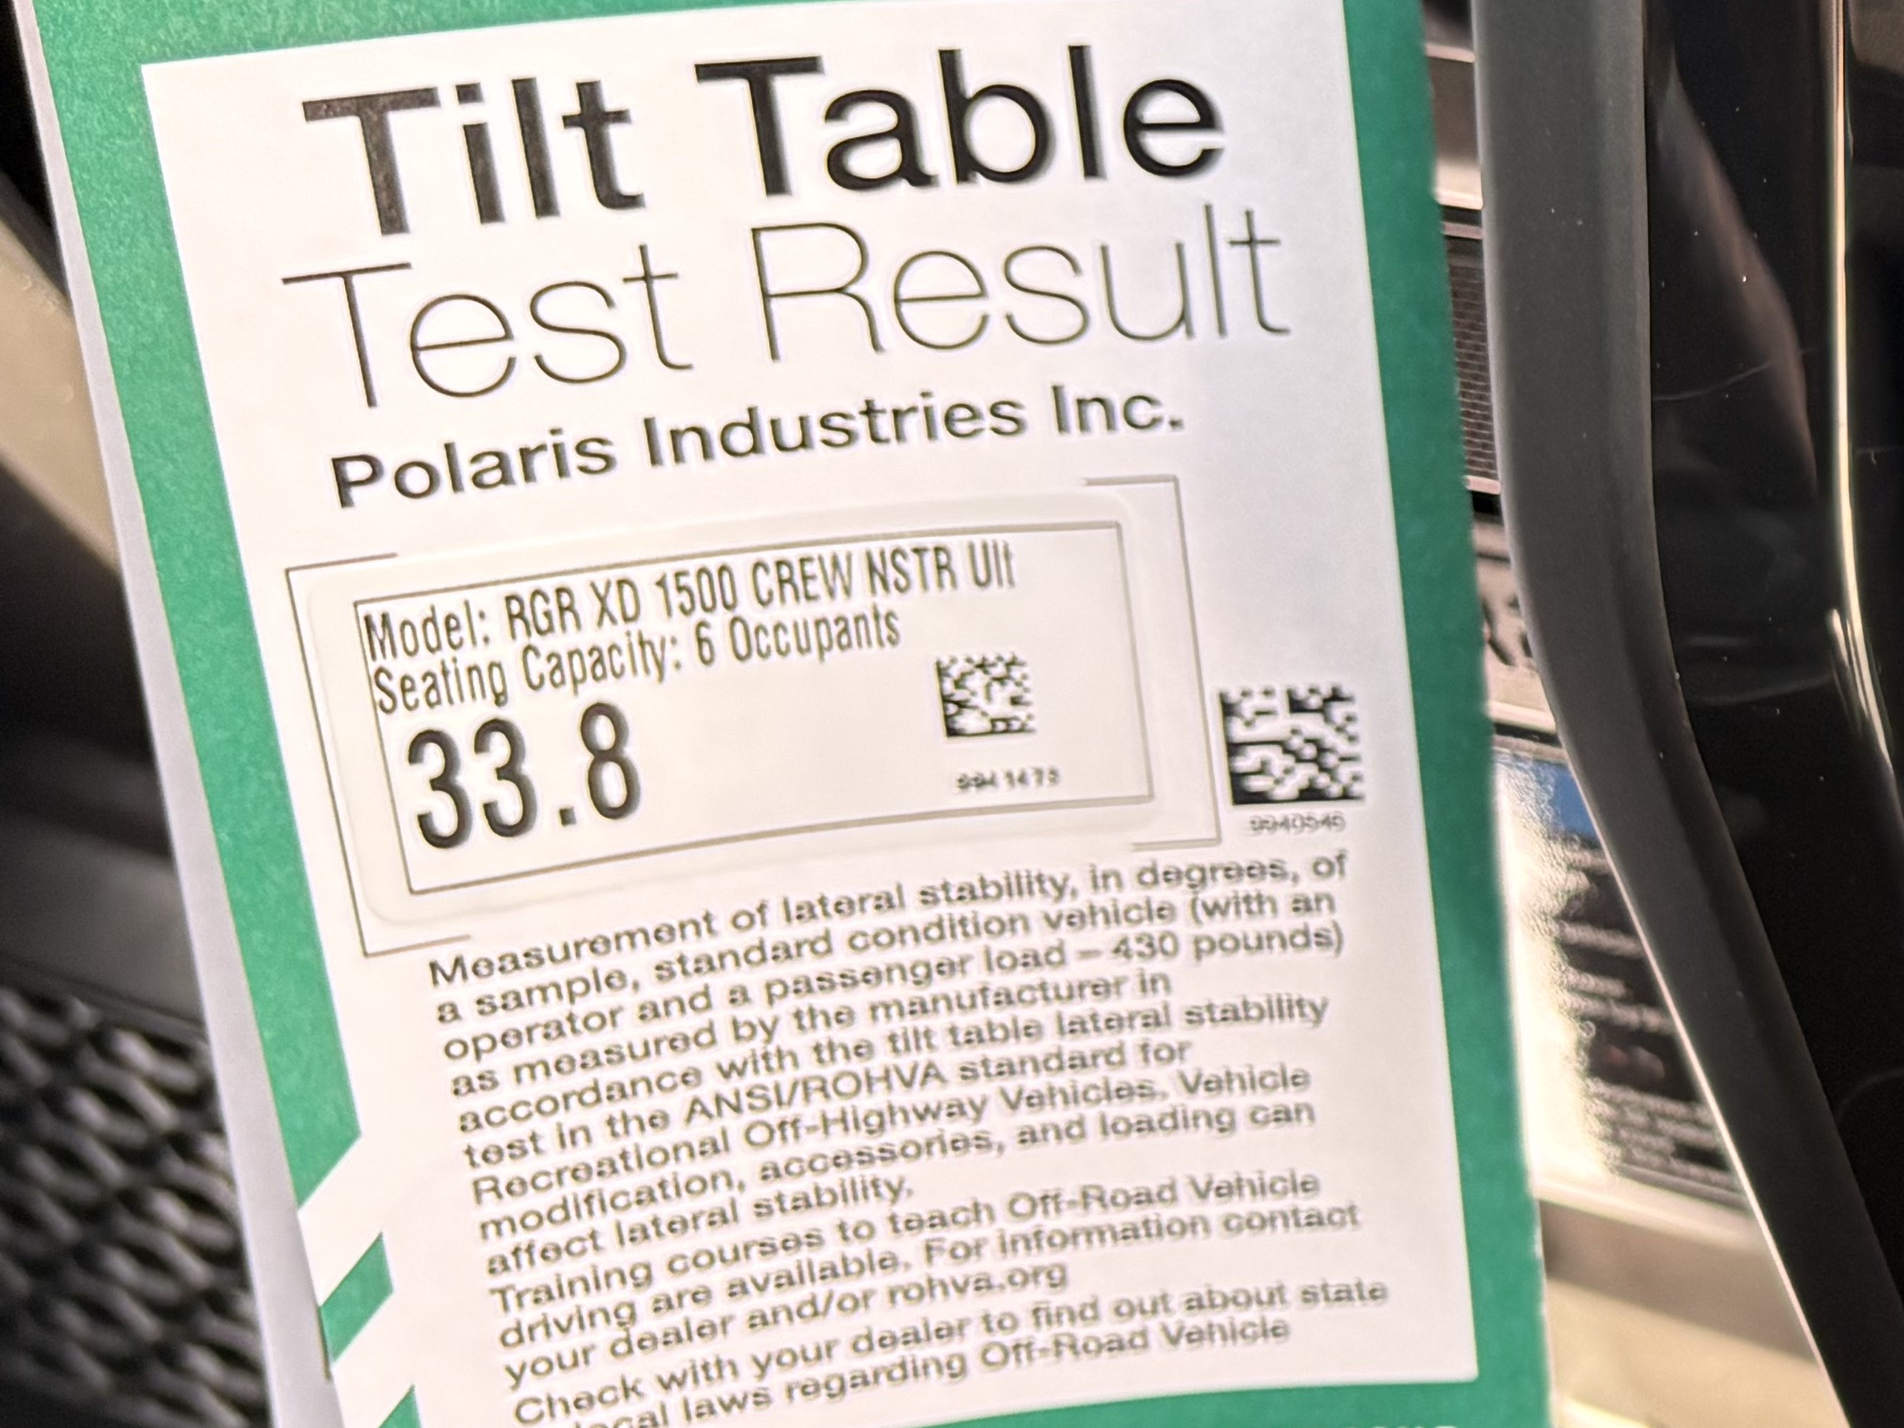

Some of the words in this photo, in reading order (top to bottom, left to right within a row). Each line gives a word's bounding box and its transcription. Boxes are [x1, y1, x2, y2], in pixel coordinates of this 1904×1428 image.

[302, 75, 645, 237] Tilt
[694, 44, 1226, 197] Table
[281, 242, 694, 408] Test
[750, 203, 1290, 360] Result
[329, 418, 617, 508] Polaris
[644, 388, 1028, 469] Industries
[1052, 384, 1185, 435] Inc.
[363, 599, 491, 662] Model:
[504, 586, 581, 643] RGR
[593, 575, 641, 627] XD
[656, 565, 739, 618] 1500
[753, 552, 853, 607] CREW
[867, 543, 956, 597] NSTR
[374, 658, 509, 715] Seating
[522, 629, 682, 694] Capacity:
[697, 622, 715, 667] 6
[729, 606, 901, 663] Occupants
[407, 702, 641, 850] 33.8
[429, 909, 718, 987] Measurement
[730, 900, 769, 933] of
[782, 882, 906, 924] lateral
[1089, 863, 1123, 892] in
[1137, 857, 1299, 889] degrees,
[1312, 850, 1348, 879] of
[436, 998, 460, 1024] a
[475, 969, 641, 1017] sample,
[655, 929, 832, 983] standard
[848, 909, 1029, 953] condition
[1043, 896, 1175, 931] vehicle
[1191, 889, 1276, 924] (with
[1291, 891, 1335, 915] an
[444, 1005, 624, 1062] operator
[638, 984, 712, 1023] and
[729, 984, 750, 1008] a
[766, 952, 973, 1005] passenger
[984, 939, 1066, 973] load
[1111, 931, 1180, 962] 430
[1193, 921, 1344, 966] pounds)
[452, 1069, 499, 1098] as
[514, 1021, 716, 1085] measured
[732, 1013, 779, 1046] by
[792, 1003, 854, 1035] the
[869, 974, 1128, 1024] manufacturer
[1139, 969, 1171, 996] in
[459, 1065, 701, 1133] accordance
[716, 1046, 800, 1079] with
[812, 1032, 874, 1065] the
[889, 1023, 936, 1056] tilt
[947, 1014, 1042, 1049] table
[1055, 1001, 1172, 1037] lateral
[1184, 995, 1328, 1030] stability
[464, 1129, 544, 1169] test
[557, 1122, 592, 1151] in
[606, 1110, 670, 1140] the
[686, 1059, 947, 1124] ANSI/ROHVA
[959, 1040, 1126, 1082] standard
[1139, 1037, 1193, 1066] for
[473, 1127, 730, 1206] Recreational
[744, 1096, 988, 1149] Off-Highway
[1179, 1062, 1310, 1095] Vehicle
[480, 1168, 746, 1241] modification,
[759, 1129, 1004, 1182] accessories,
[1017, 1114, 1086, 1146] and
[1099, 1102, 1236, 1137] loading
[1248, 1099, 1315, 1129] can
[487, 1228, 605, 1275] affect
[615, 1199, 739, 1246] lateral
[490, 1261, 653, 1313] Training
[667, 1230, 825, 1274] courses
[837, 1216, 875, 1243] to
[890, 1198, 995, 1234] teach
[1008, 1177, 1178, 1221] Off-Road
[1186, 1168, 1320, 1204] Vehicle
[499, 1300, 638, 1349] driving
[651, 1287, 713, 1314] are
[727, 1248, 911, 1298] available.
[924, 1233, 987, 1265] For
[999, 1208, 1211, 1258] information
[1223, 1201, 1361, 1234] contact
[504, 1343, 597, 1390] your
[609, 1312, 737, 1359] dealer
[747, 1287, 875, 1330] and/or
[888, 1264, 1067, 1306] rohva.org
[513, 1373, 643, 1425] Check
[655, 1355, 738, 1391] with
[752, 1339, 839, 1380] your
[851, 1318, 972, 1355] dealer
[982, 1309, 1018, 1336] to
[1031, 1295, 1100, 1326] find
[1113, 1288, 1171, 1320] out
[1185, 1279, 1286, 1312] about
[1300, 1277, 1389, 1305] state
[683, 1388, 772, 1423] laws
[785, 1355, 967, 1404] regarding
[980, 1325, 1148, 1370] Off-Road
[1159, 1317, 1291, 1349] Vehicle
